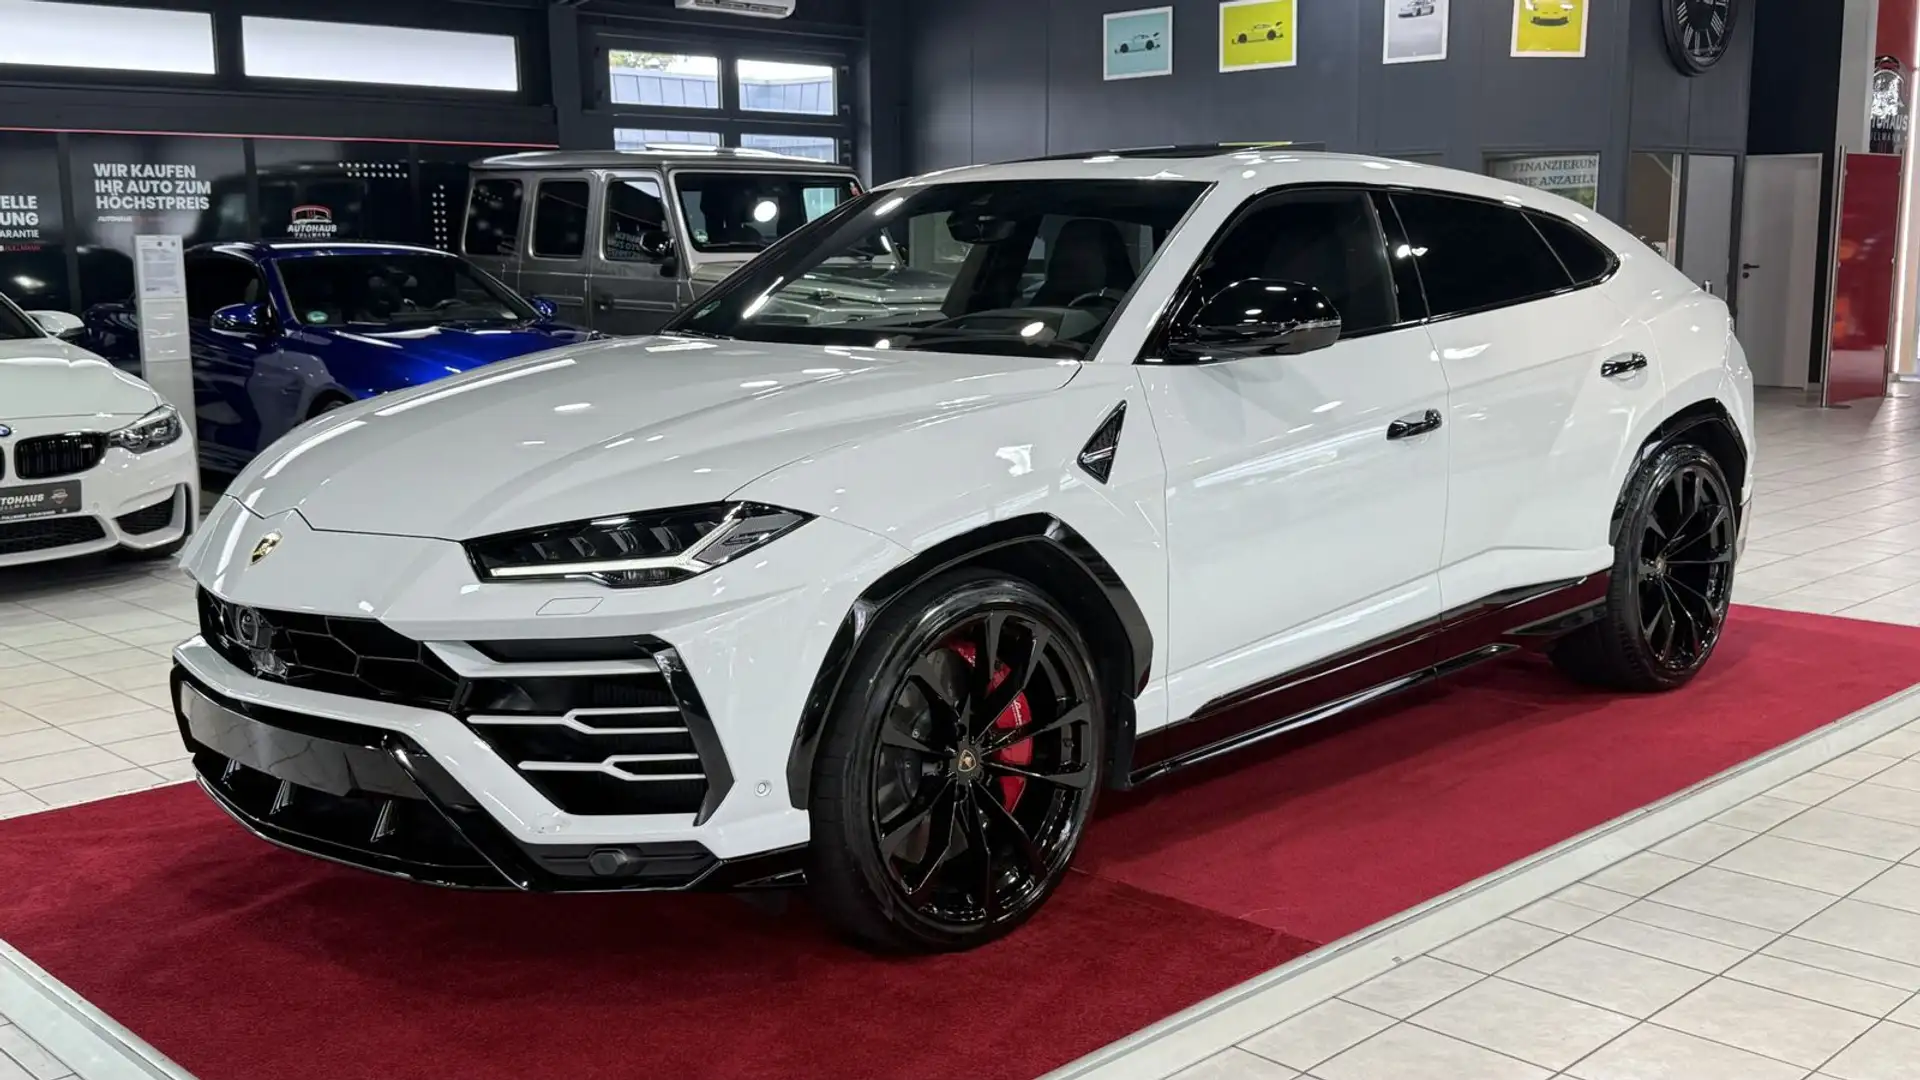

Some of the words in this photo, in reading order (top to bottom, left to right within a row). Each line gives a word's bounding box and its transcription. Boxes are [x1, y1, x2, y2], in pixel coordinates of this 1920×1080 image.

[93, 163, 128, 177] WIR
[130, 164, 196, 178] KAUFEN
[94, 180, 124, 194] IHR
[126, 181, 173, 194] AUTO
[174, 181, 212, 195] ZUM
[96, 190, 210, 210] HÖCHSTPREIS
[287, 224, 337, 232] AUTOHAUS
